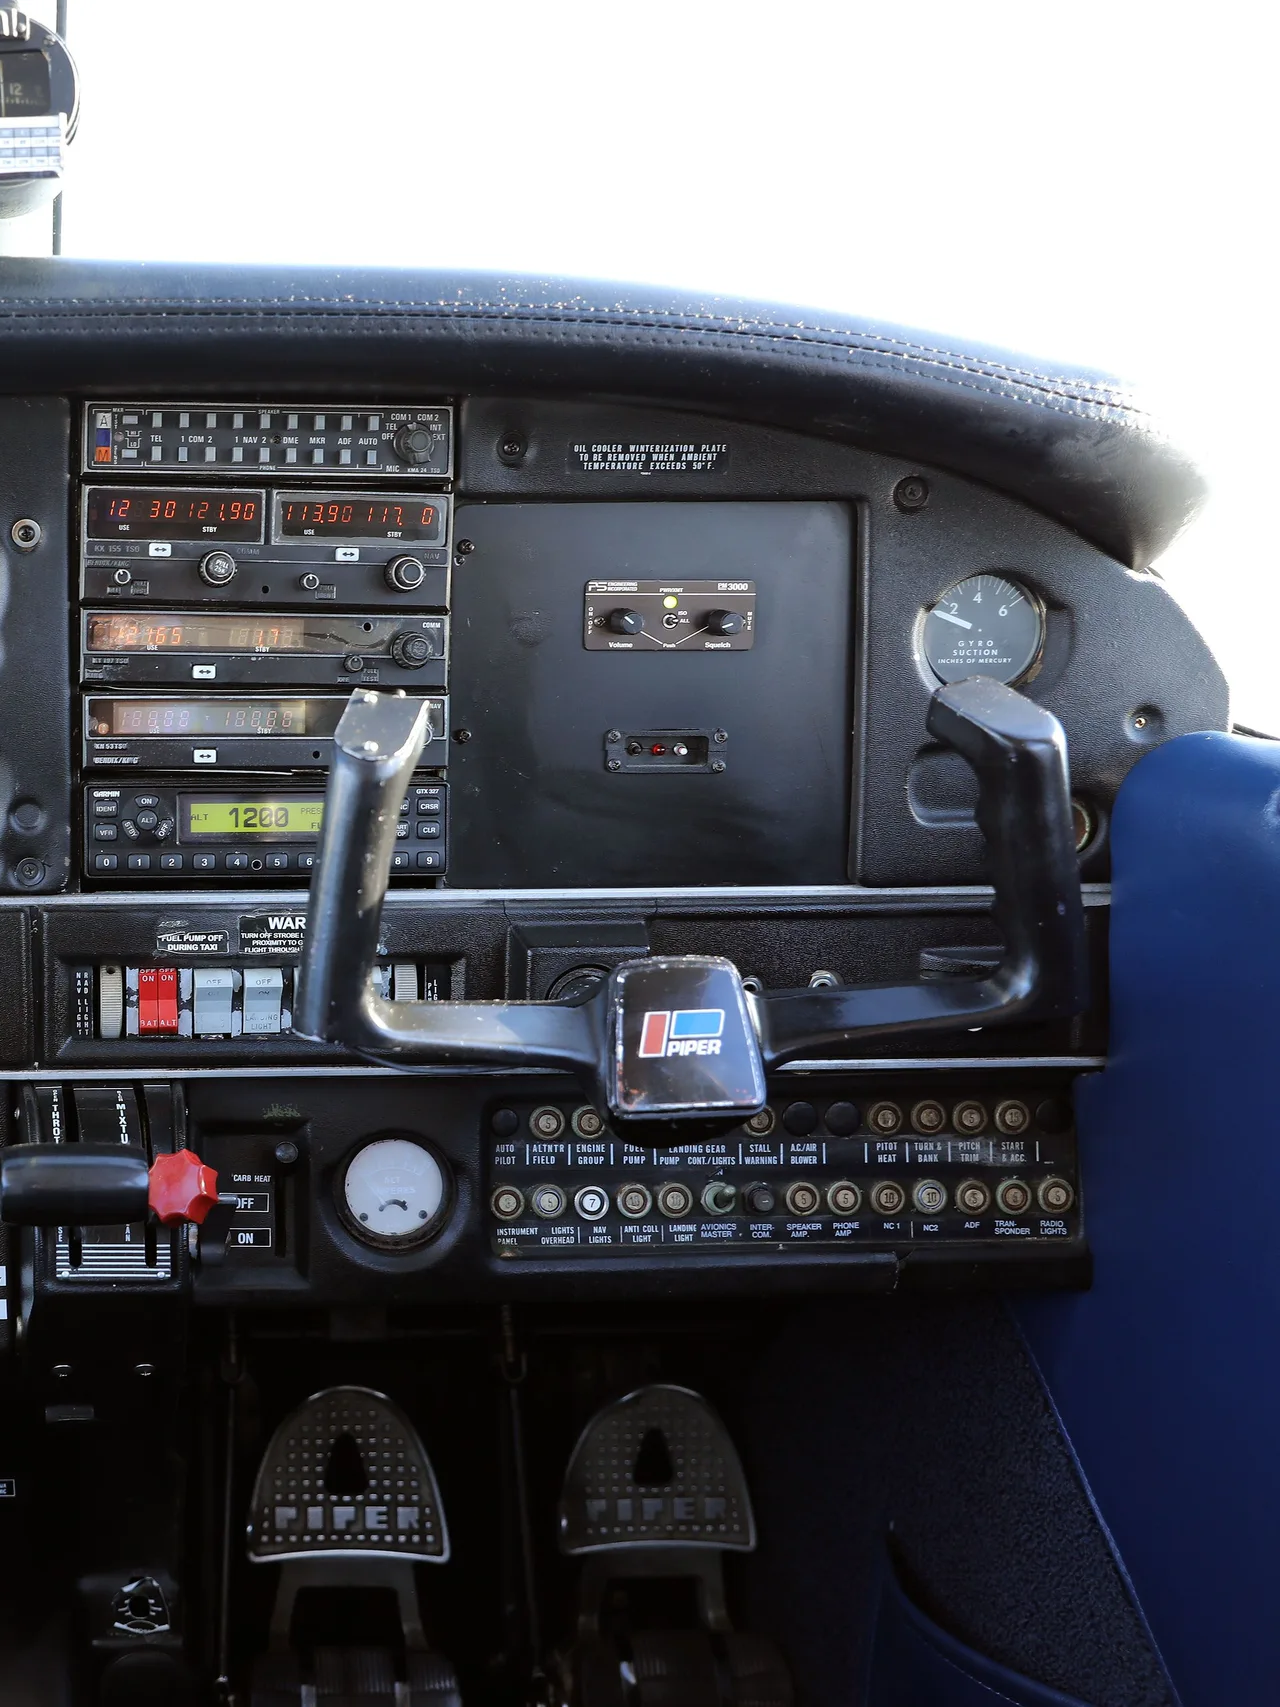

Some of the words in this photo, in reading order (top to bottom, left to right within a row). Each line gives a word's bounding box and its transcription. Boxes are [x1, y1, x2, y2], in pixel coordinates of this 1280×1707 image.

[10, 83, 23, 95] 12
[150, 435, 163, 443] TEL
[188, 435, 204, 443] COM
[243, 436, 258, 444] NAV
[358, 438, 378, 446] AUTO
[629, 444, 694, 452] WINTERIZATION
[701, 444, 727, 452] PLATE
[652, 453, 674, 461] WHEN
[681, 453, 717, 461] AMBIENT
[385, 465, 400, 473] MIC
[583, 462, 643, 470] TEMPERATURE
[649, 462, 686, 470] EXCEEDS
[973, 592, 982, 603] 4
[998, 604, 1008, 617] 6
[228, 807, 289, 828] 1200
[667, 1039, 722, 1057] PIPER
[576, 1144, 606, 1153] ENGINE
[749, 1144, 771, 1153] STALL
[876, 1142, 898, 1151] PITOT
[495, 1157, 516, 1165] PILOT
[533, 1156, 556, 1165] FIELD
[578, 1157, 605, 1165] GROUP
[744, 1156, 778, 1165] WARNING
[791, 1156, 818, 1165] BLOWER
[877, 1154, 897, 1163] HEAT
[701, 1223, 737, 1231] AVIONICS
[786, 1223, 822, 1231] SPEAKER
[964, 1221, 981, 1229] ADF
[1040, 1220, 1064, 1228] RADIO
[551, 1227, 575, 1235] LIGHTS
[541, 1236, 575, 1245] OVERHEAD
[274, 1505, 420, 1530] PIPER
